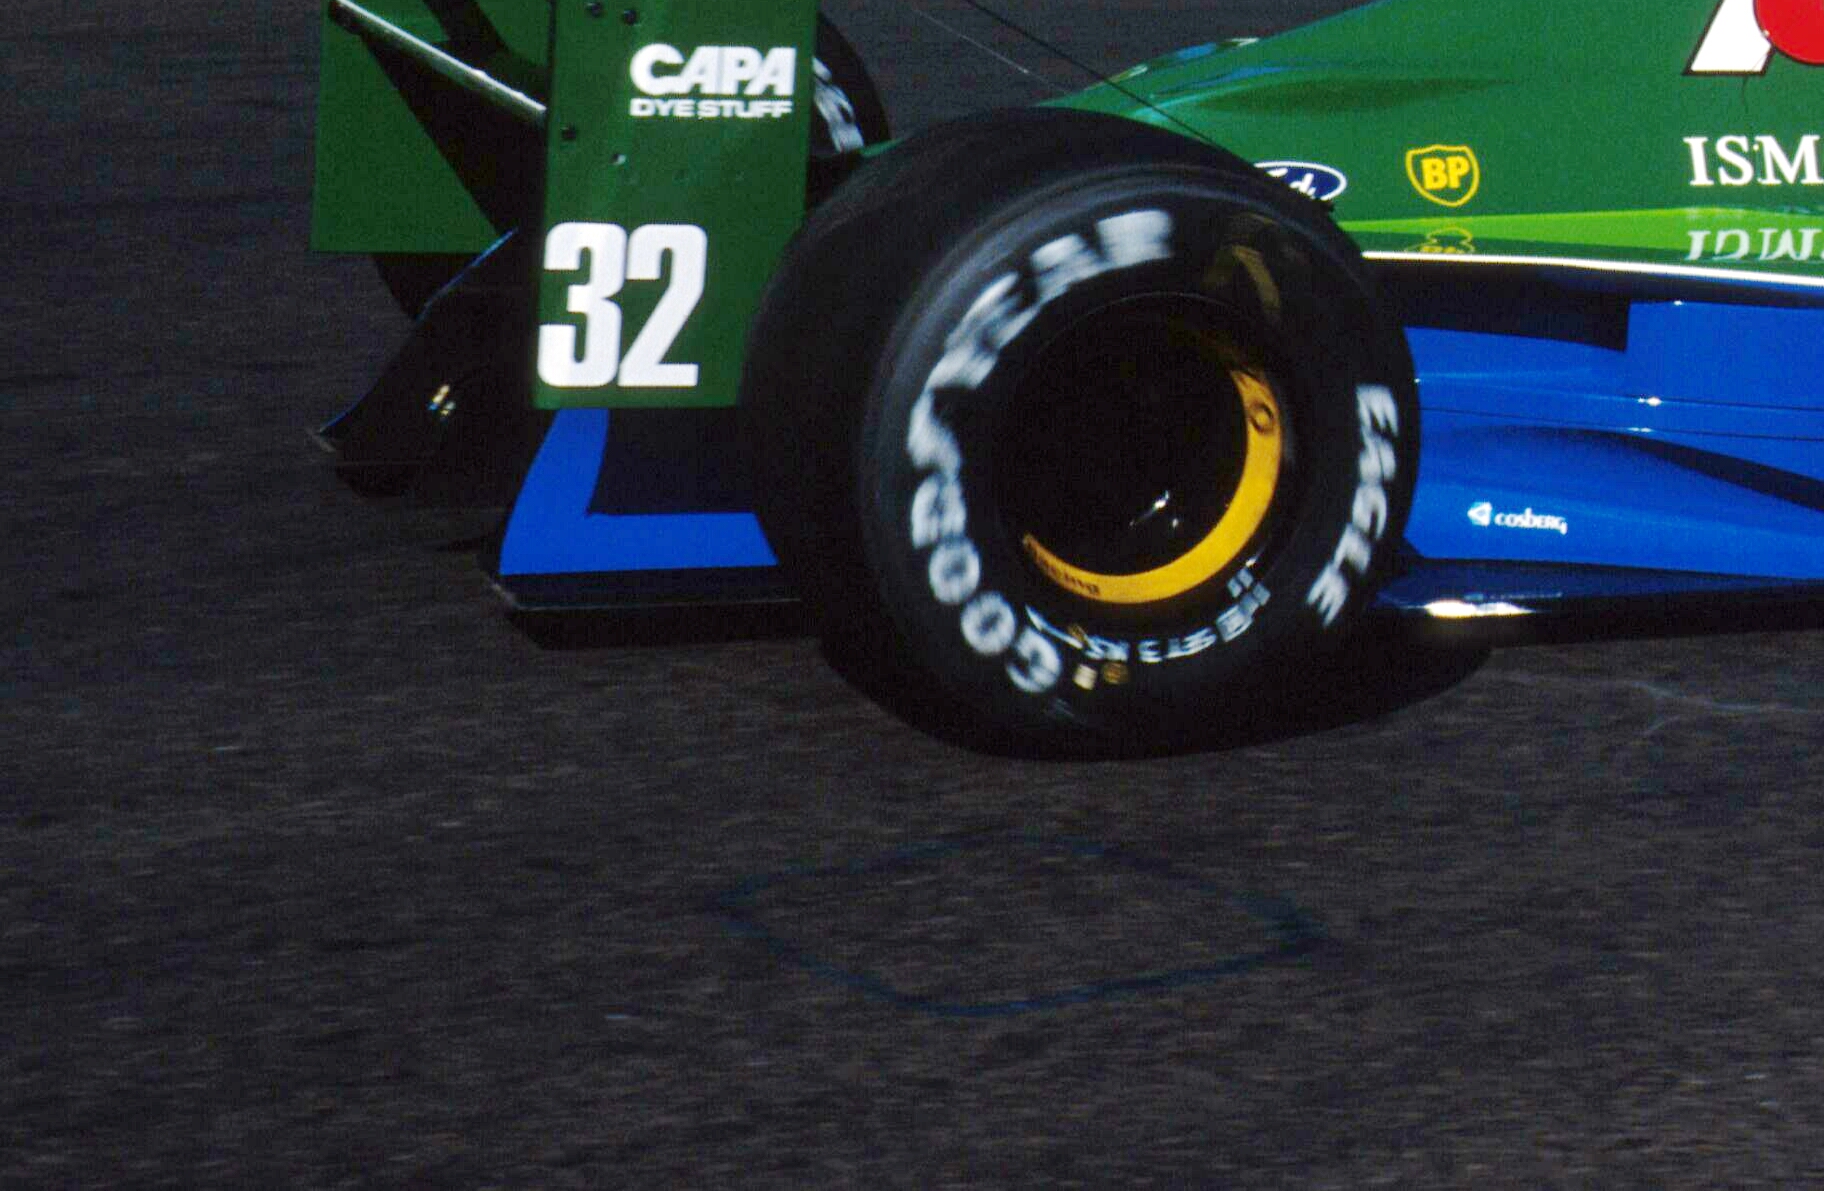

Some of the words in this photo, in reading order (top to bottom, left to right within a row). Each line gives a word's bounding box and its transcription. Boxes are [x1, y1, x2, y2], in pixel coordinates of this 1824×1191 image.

[630, 44, 796, 97] CAPA
[1420, 156, 1470, 190] BP
[537, 221, 707, 387] 32
